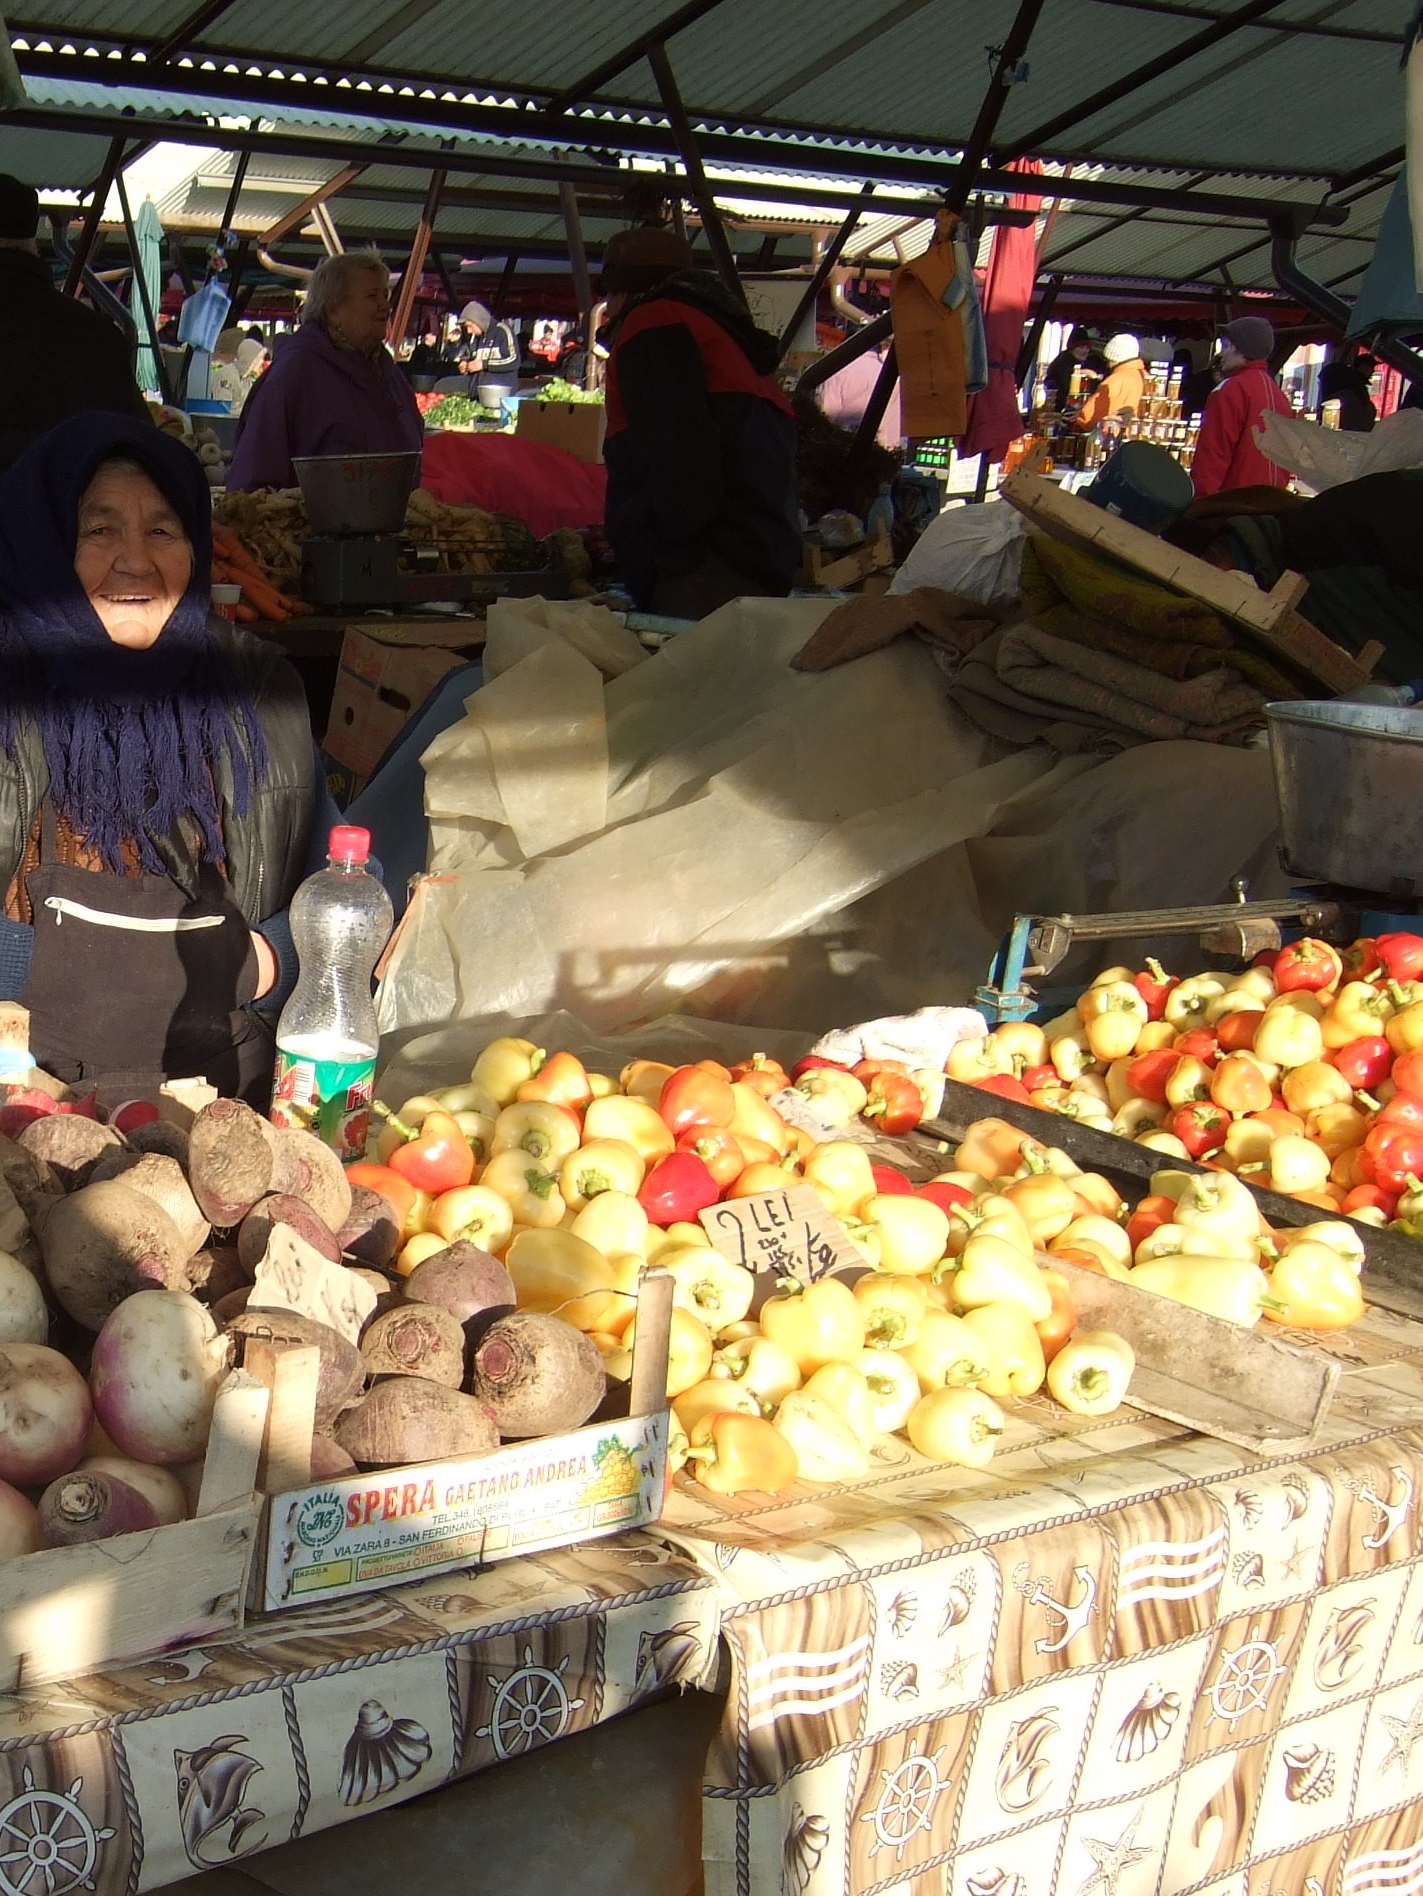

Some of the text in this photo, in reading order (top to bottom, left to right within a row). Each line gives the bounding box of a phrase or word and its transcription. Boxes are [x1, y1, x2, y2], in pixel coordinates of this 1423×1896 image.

[750, 1192, 794, 1232] LEI
[304, 1492, 341, 1512] ITALIA
[345, 1478, 437, 1529] SPERA
[445, 1471, 521, 1507] GAETANO
[523, 1455, 588, 1488] ANDREA
[334, 1545, 352, 1557] VIA
[353, 1540, 382, 1553] ZARA
[398, 1532, 421, 1545] SAN
[422, 1516, 487, 1541] FERDINANDO
